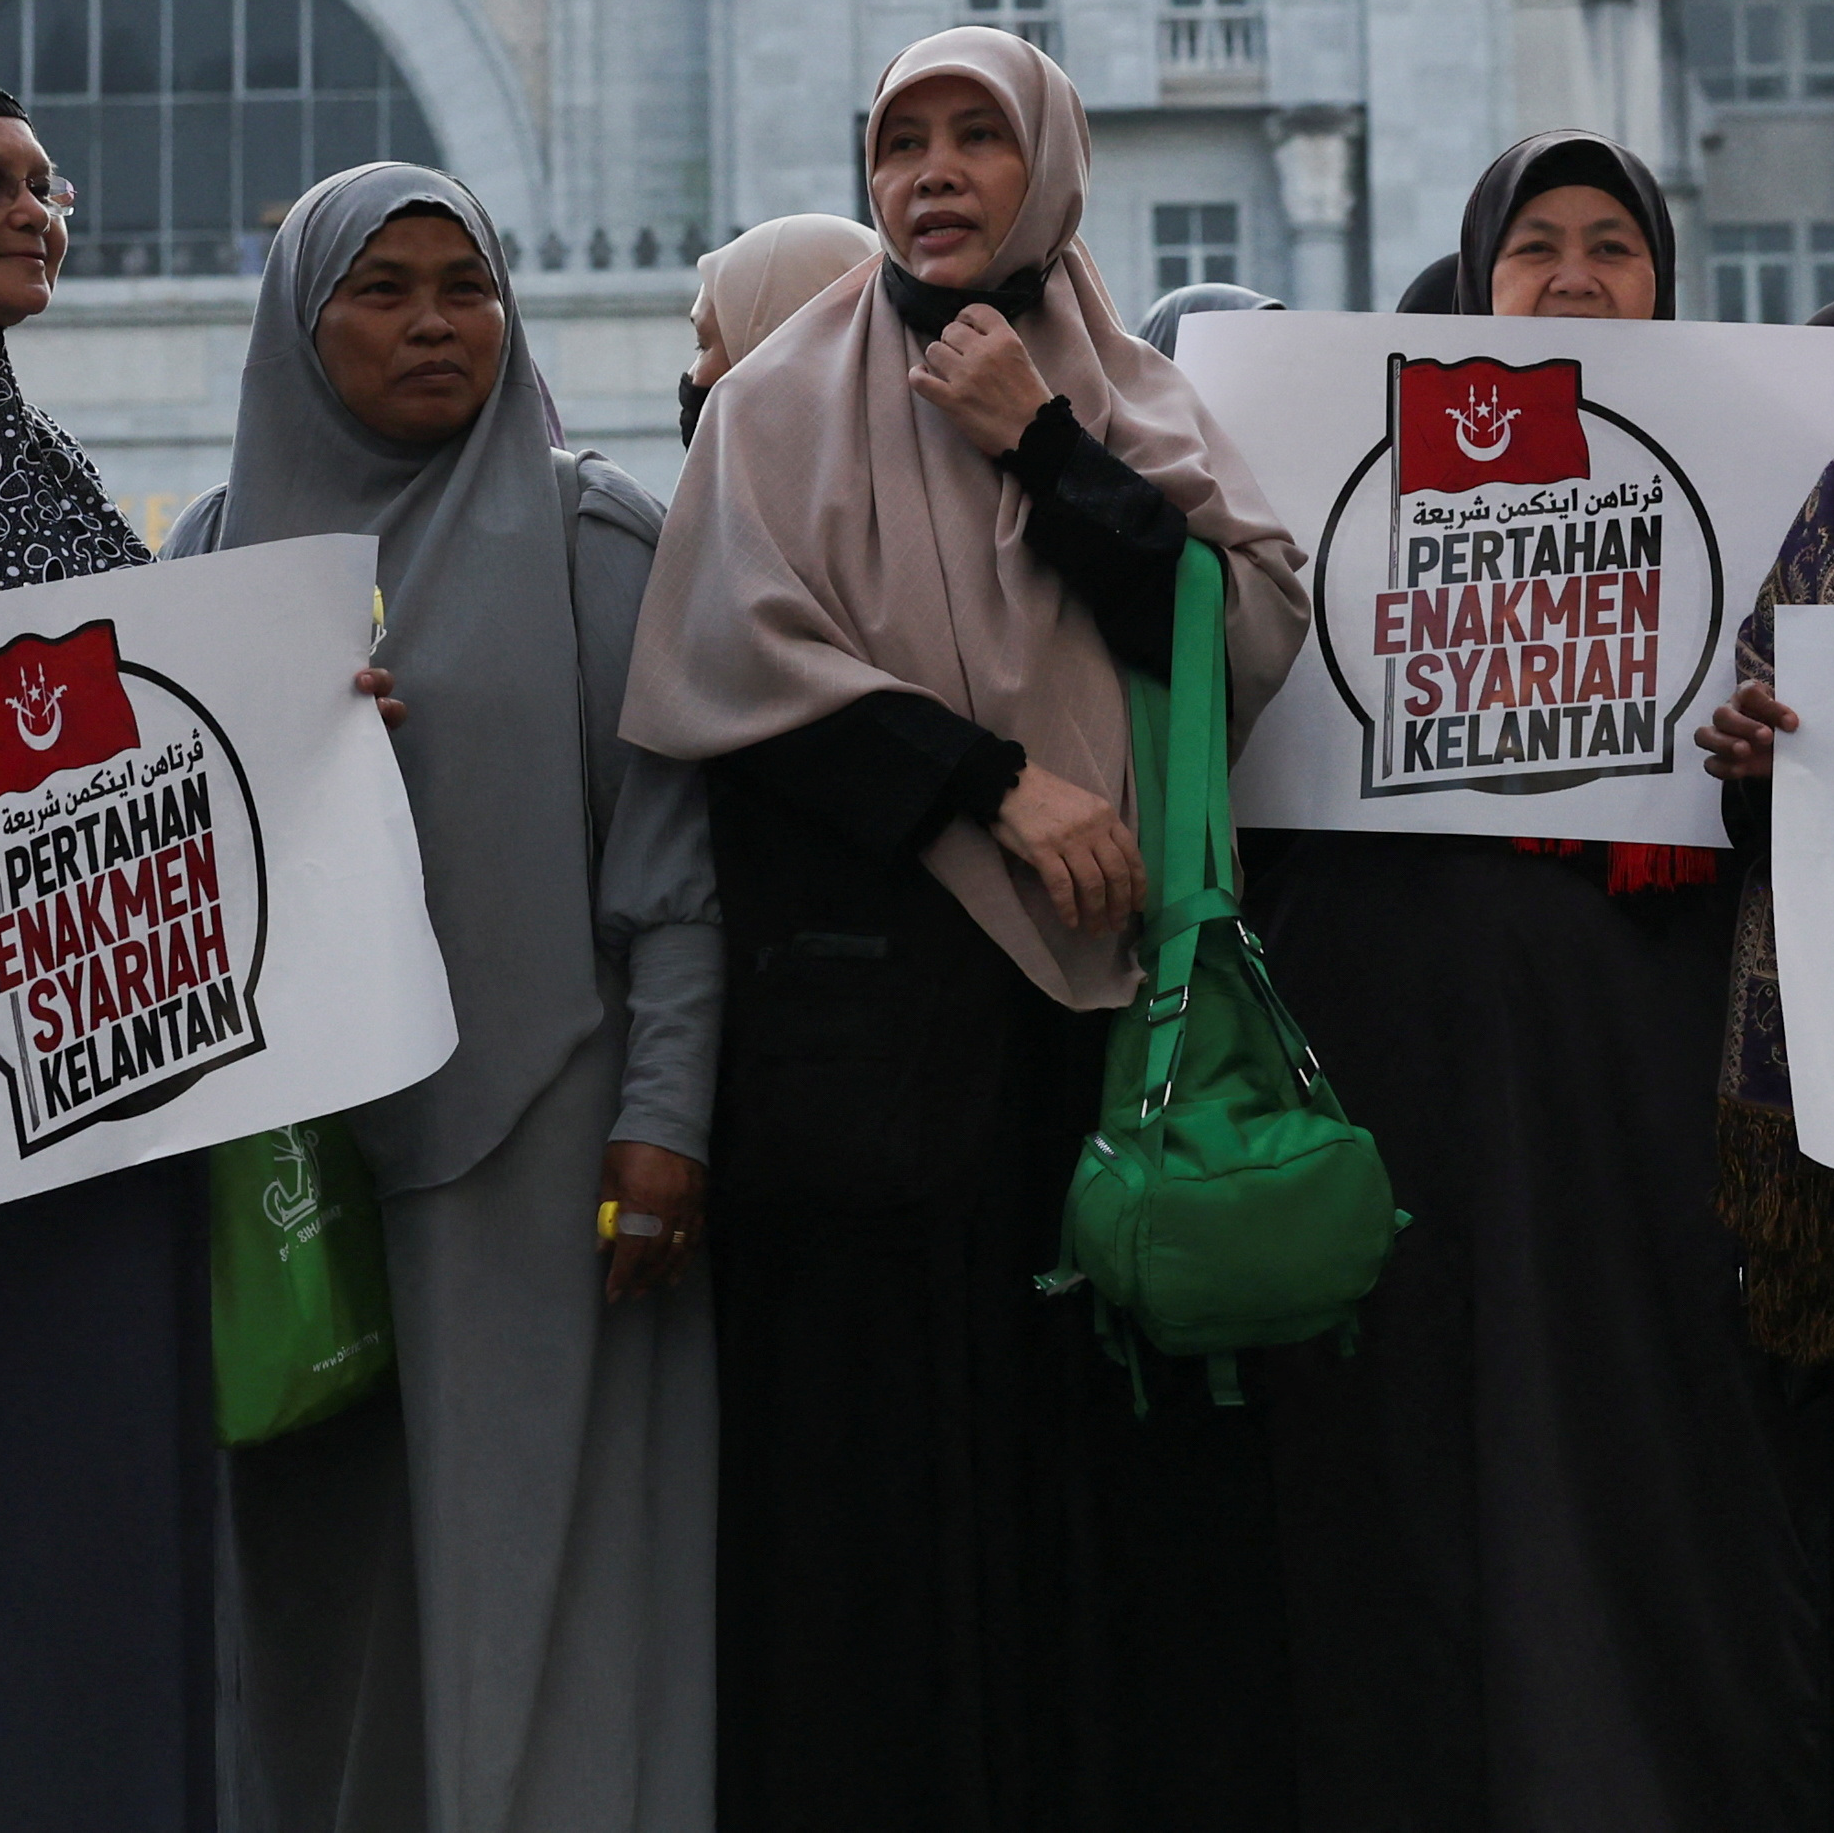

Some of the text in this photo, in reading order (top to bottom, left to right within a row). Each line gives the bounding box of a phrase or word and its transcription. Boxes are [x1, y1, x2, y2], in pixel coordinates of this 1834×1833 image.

[1408, 515, 1662, 588] PERTAHAN
[1374, 569, 1661, 656] ENAKMEN
[1404, 635, 1658, 717] SYARIAH
[1404, 700, 1656, 773] KELANTAN
[5, 770, 212, 909] PERTAHAN
[28, 904, 230, 1054] SYARIAH
[39, 976, 243, 1119] KELANTAN
